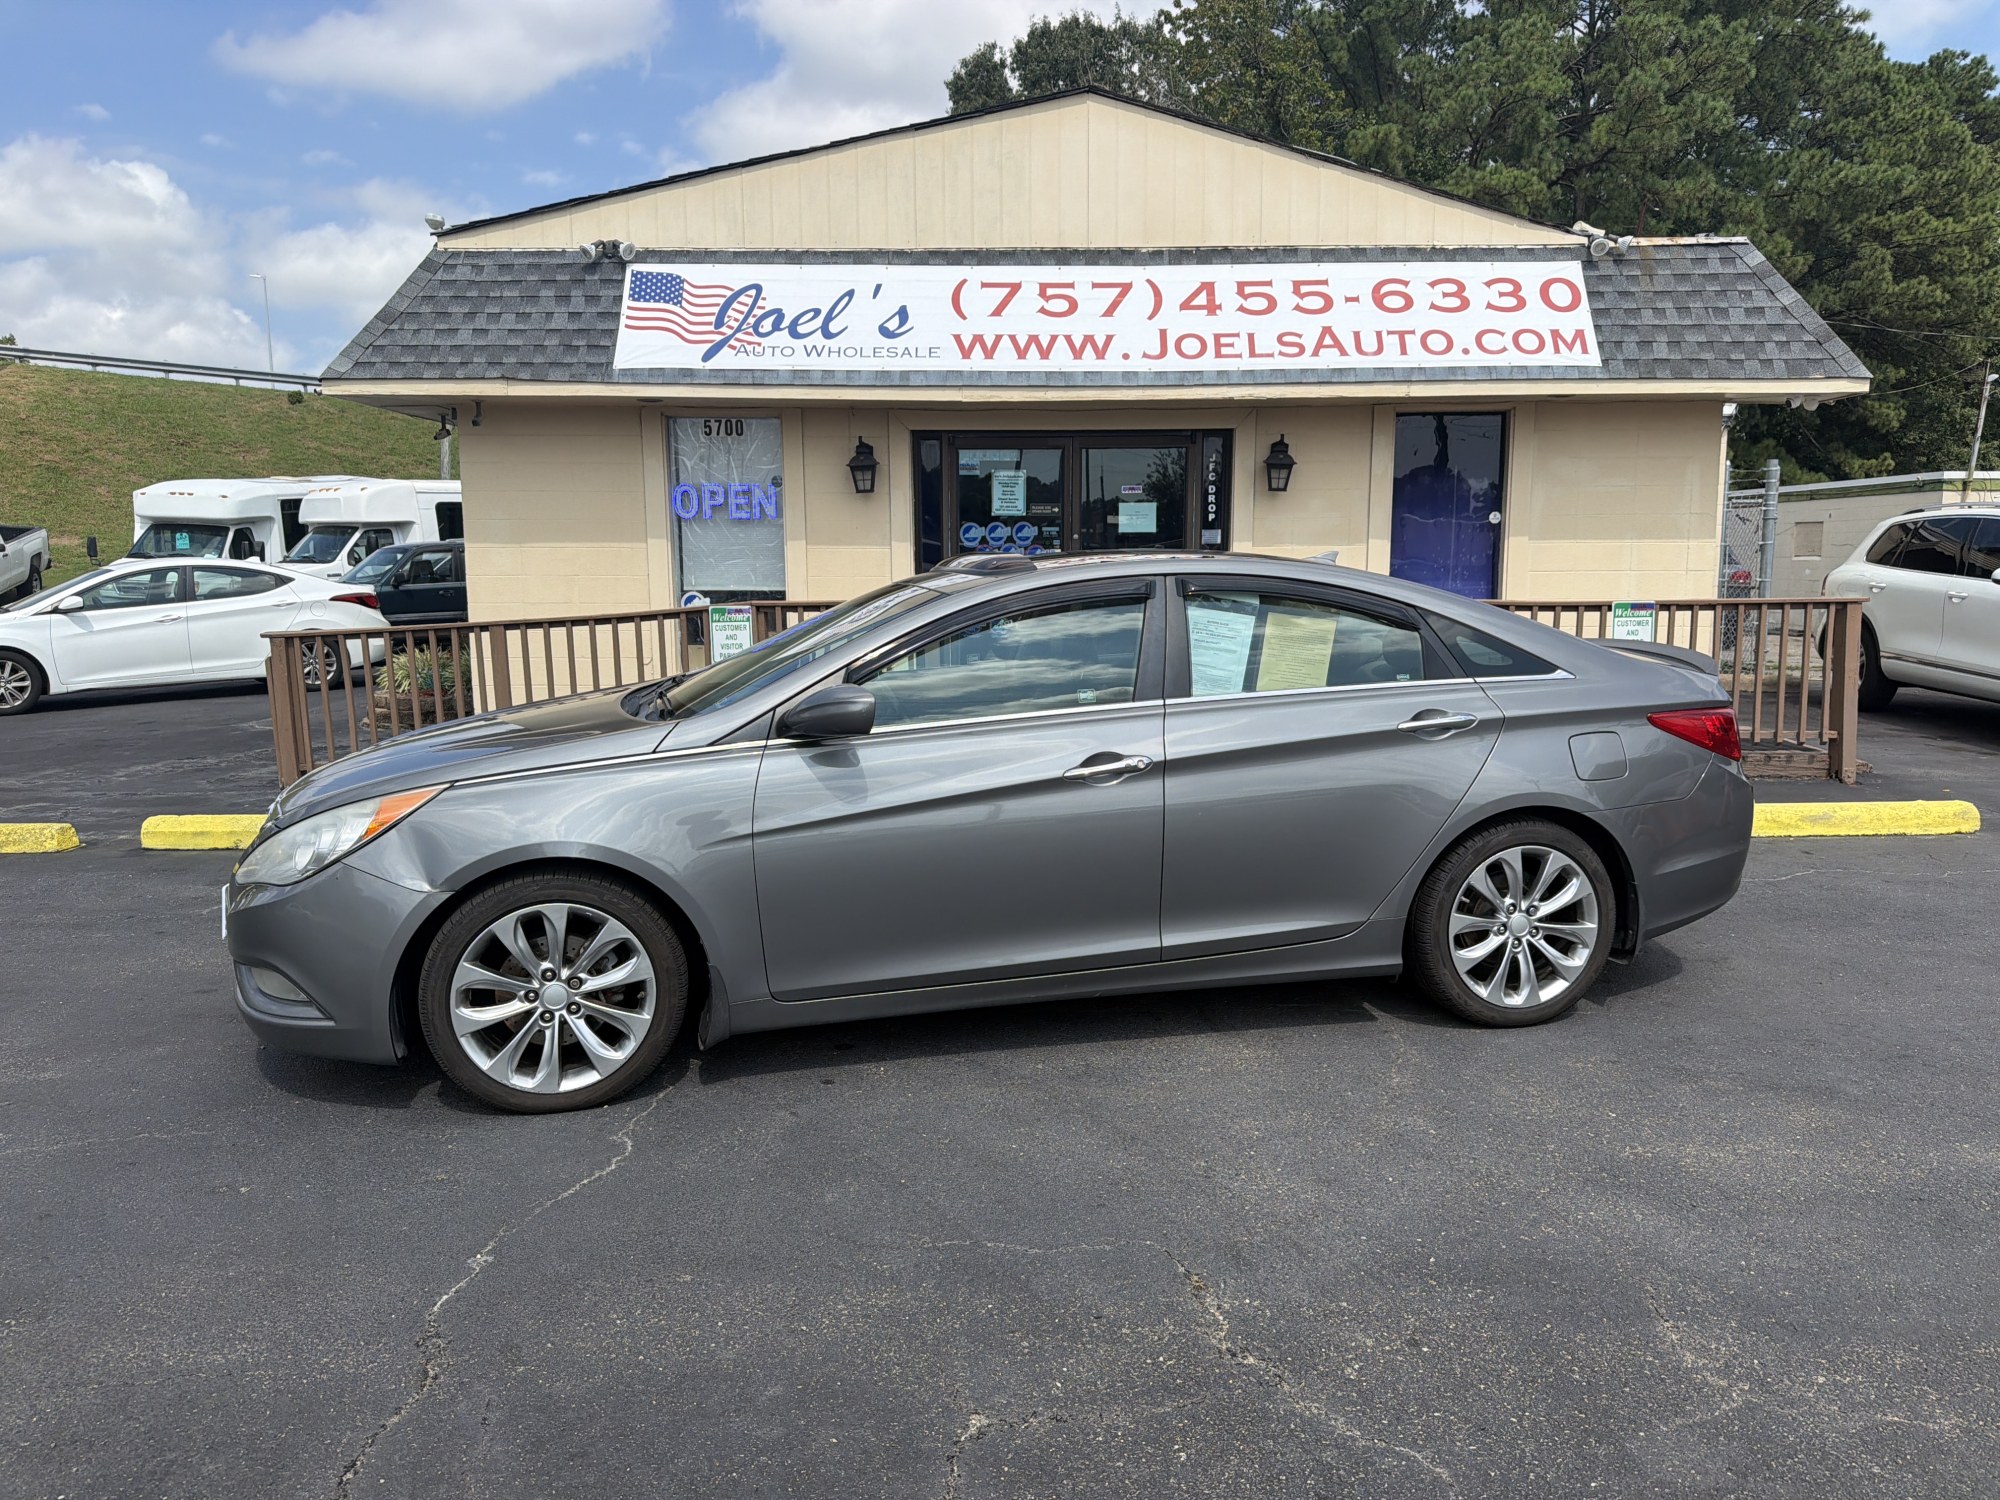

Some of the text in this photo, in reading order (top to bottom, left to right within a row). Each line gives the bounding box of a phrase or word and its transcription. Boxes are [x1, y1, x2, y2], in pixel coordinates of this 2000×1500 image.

[701, 283, 914, 363] Joel's
[734, 343, 941, 359] AUTO WHOLESALE
[704, 419, 743, 436] 5700
[1208, 453, 1217, 481] JFC
[673, 482, 778, 521] OPEN
[1207, 485, 1217, 522] DROP
[712, 613, 748, 622] Welcome
[1615, 608, 1651, 617] Welcome
[714, 624, 748, 632] CUSTOMER
[725, 633, 738, 641] AND
[720, 642, 744, 650] VISITOR
